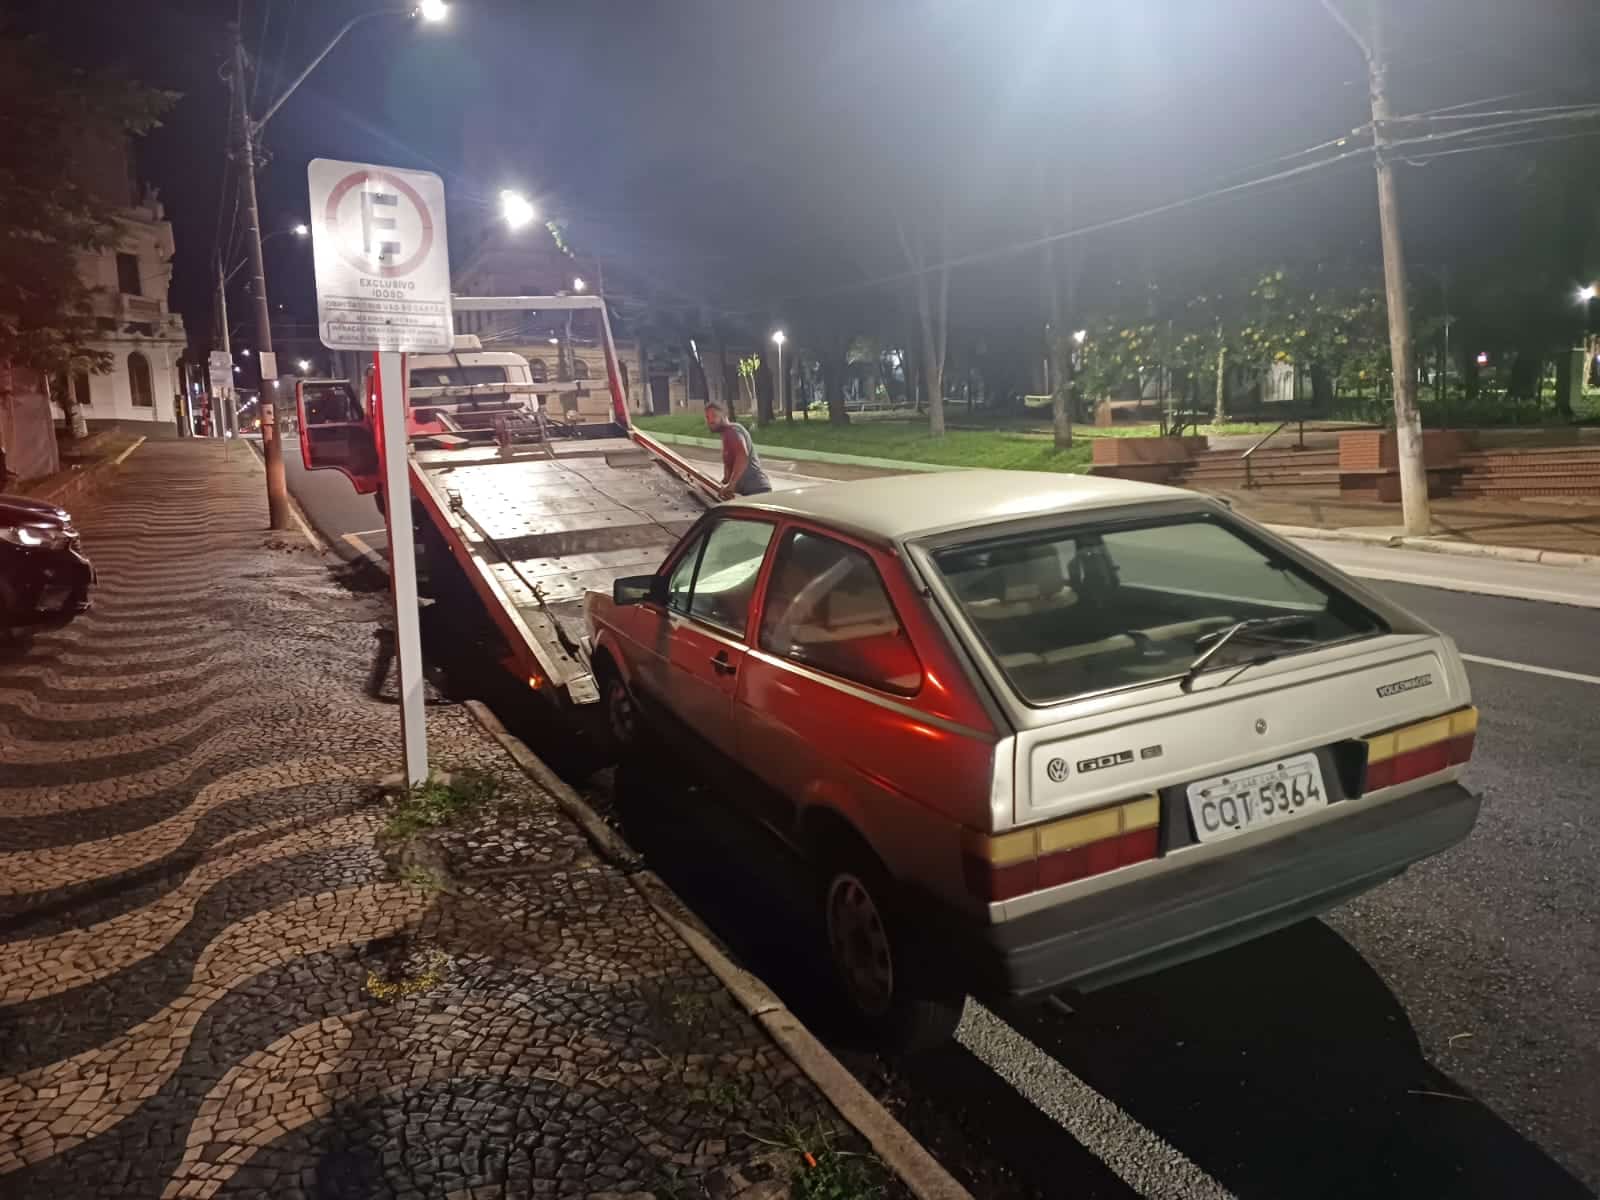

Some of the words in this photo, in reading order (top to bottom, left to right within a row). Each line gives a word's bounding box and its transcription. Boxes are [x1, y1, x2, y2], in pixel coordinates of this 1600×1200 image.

[359, 278, 415, 290] EXCLUSIVO
[372, 289, 404, 298] IDOSO
[1077, 750, 1134, 774] GOL
[1202, 791, 1251, 831] CQT
[1259, 774, 1320, 815] 5364
